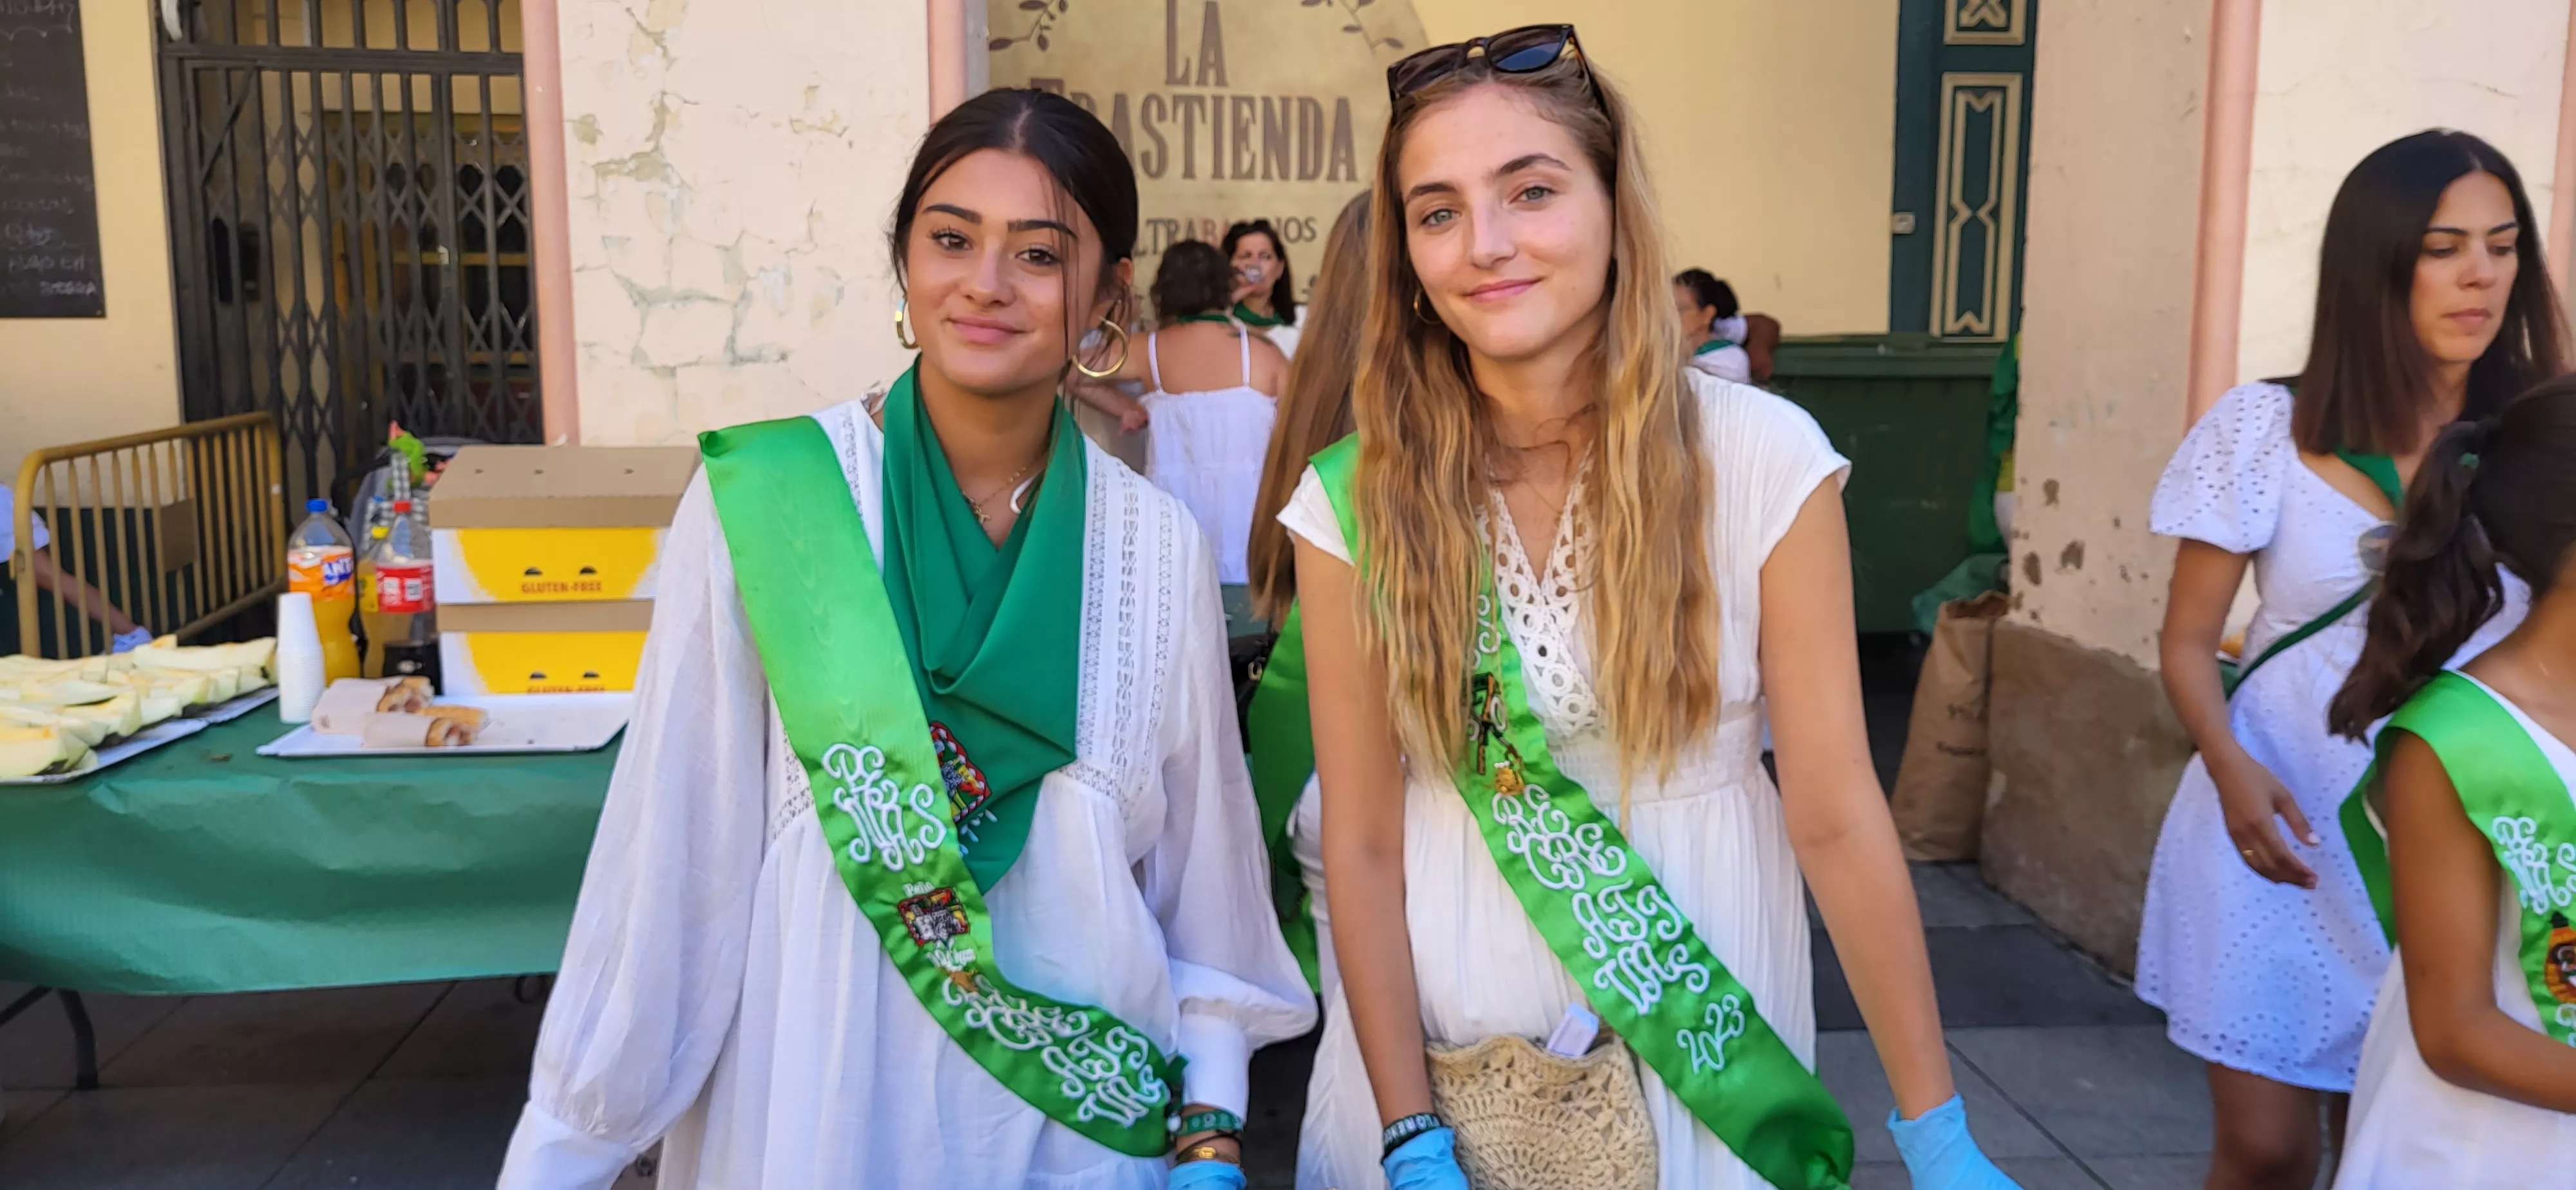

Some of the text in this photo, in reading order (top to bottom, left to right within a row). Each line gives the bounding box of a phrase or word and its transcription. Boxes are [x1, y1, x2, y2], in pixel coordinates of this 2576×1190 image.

[1164, 0, 1229, 88] LA
[520, 581, 603, 596] GLUTEN-FREE
[1677, 993, 1745, 1075] 2023
